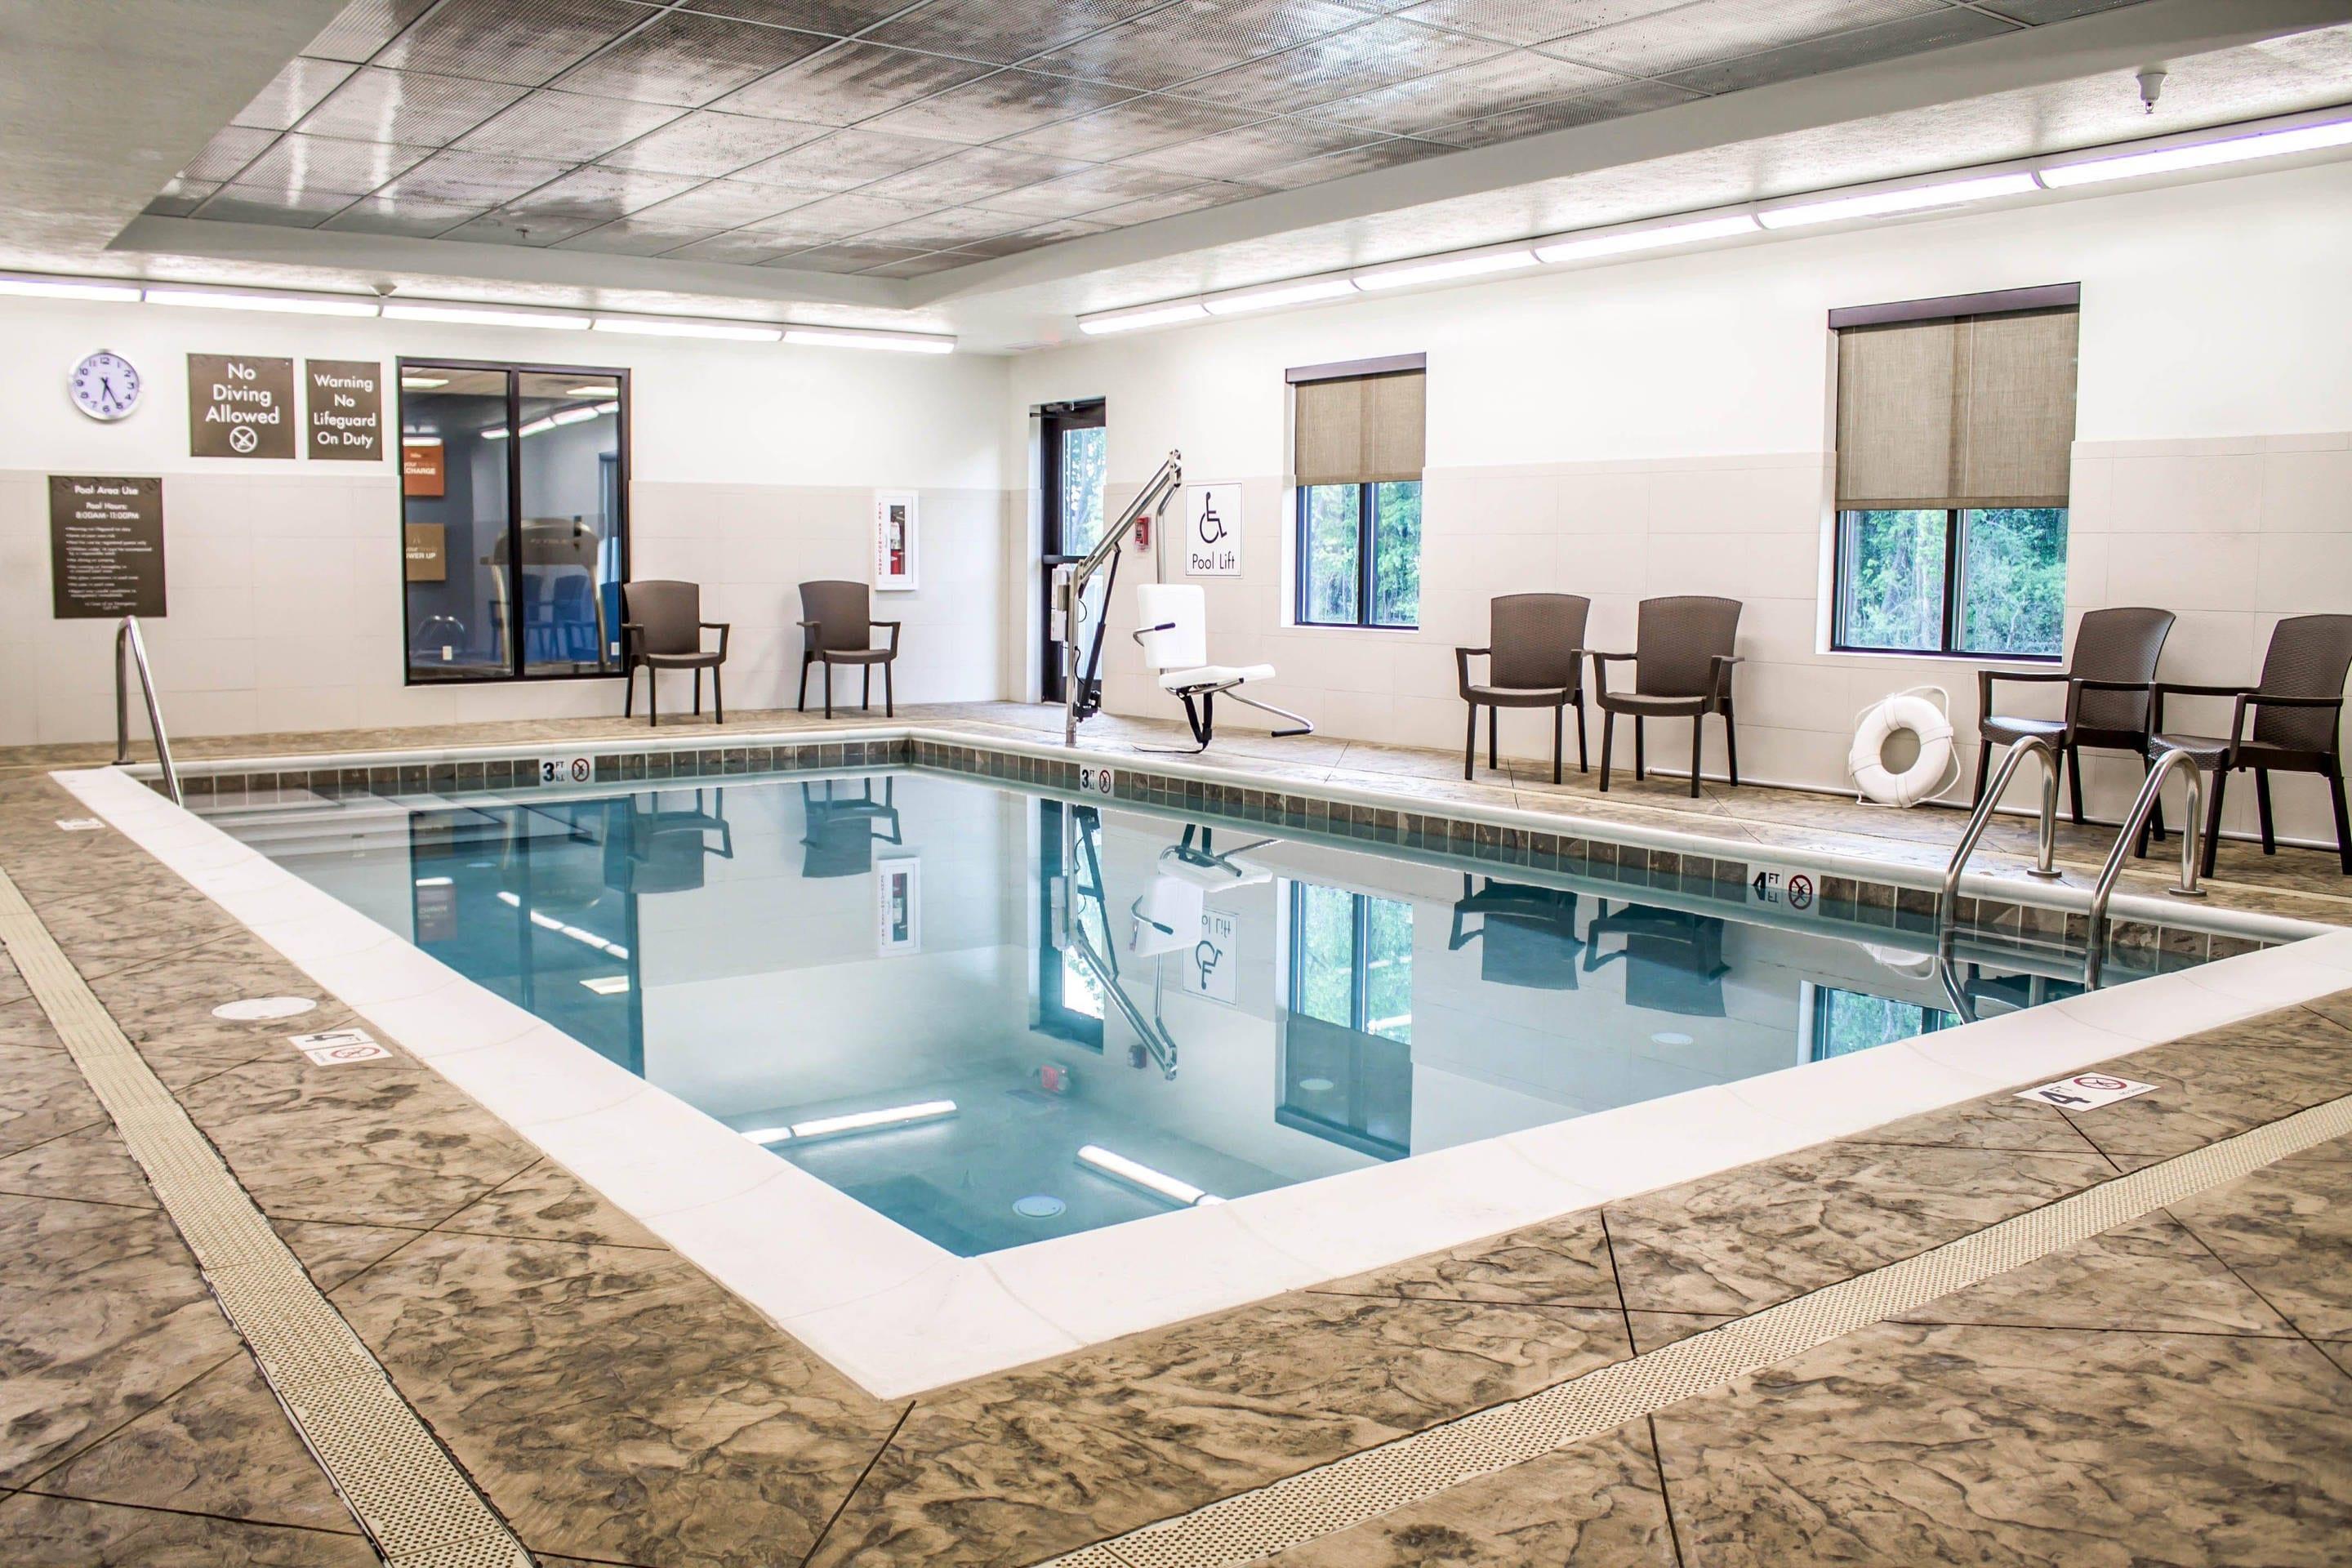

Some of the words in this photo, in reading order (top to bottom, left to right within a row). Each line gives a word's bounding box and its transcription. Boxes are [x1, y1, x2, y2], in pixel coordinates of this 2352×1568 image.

[228, 363, 256, 380] No
[314, 374, 373, 392] Warning
[213, 384, 271, 407] Diving
[334, 394, 355, 408] No
[206, 404, 279, 425] Allowed
[314, 411, 376, 430] Lifeguard
[317, 431, 338, 445] On
[343, 432, 373, 448] Duty
[74, 485, 94, 494] Pool
[97, 486, 119, 495] Area
[122, 486, 139, 495] Use
[86, 501, 102, 510] Pool
[1192, 551, 1214, 569] Pool
[1219, 550, 1235, 569] Lift
[543, 762, 555, 782] 3
[1081, 769, 1089, 789] 3
[1768, 873, 1780, 884] FT
[2038, 1090, 2091, 1105] 4
